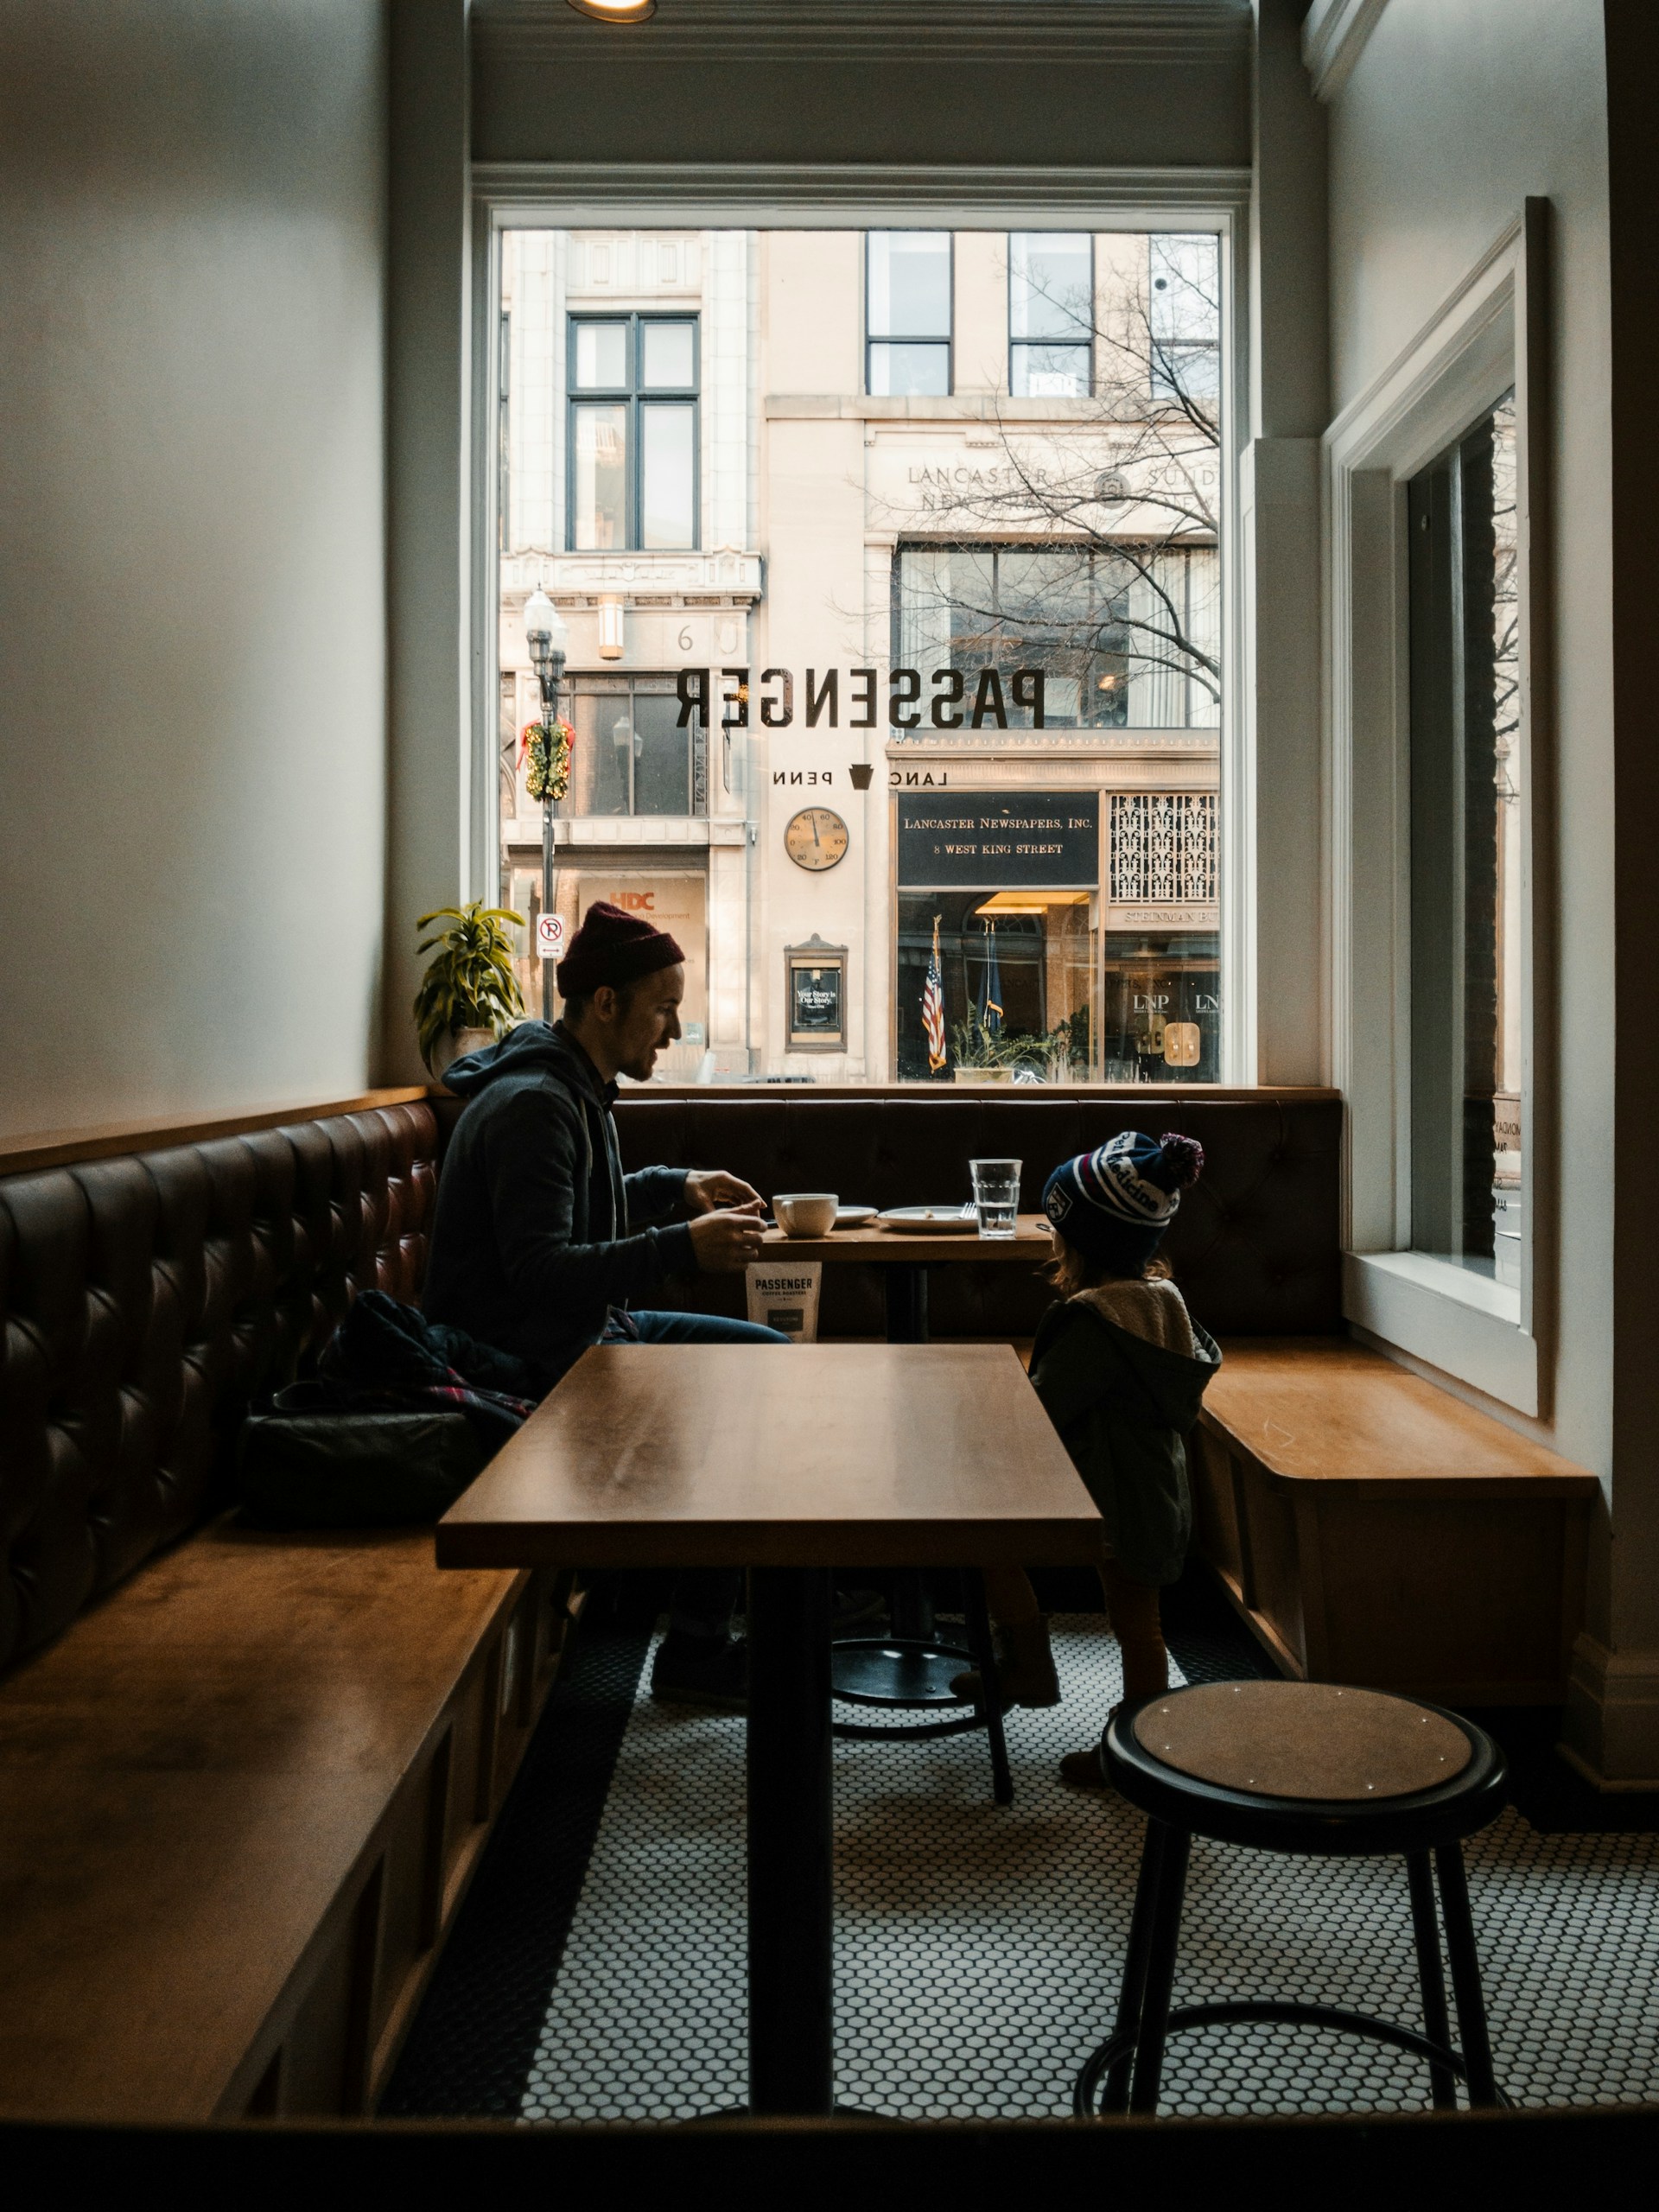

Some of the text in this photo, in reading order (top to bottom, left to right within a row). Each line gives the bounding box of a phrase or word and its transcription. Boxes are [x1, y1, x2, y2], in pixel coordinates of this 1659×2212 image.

[909, 467, 1047, 484] LANCASTER
[677, 624, 694, 652] 6
[934, 845, 1063, 855] 8 WEST KING STREET
[609, 892, 655, 911] HDC
[645, 912, 690, 921] Development
[1124, 912, 1196, 923] STEINMAN
[812, 990, 830, 999] Story
[814, 996, 832, 1005] Story.
[1134, 995, 1170, 1010] LNP
[755, 1278, 812, 1290] PASSENGER
